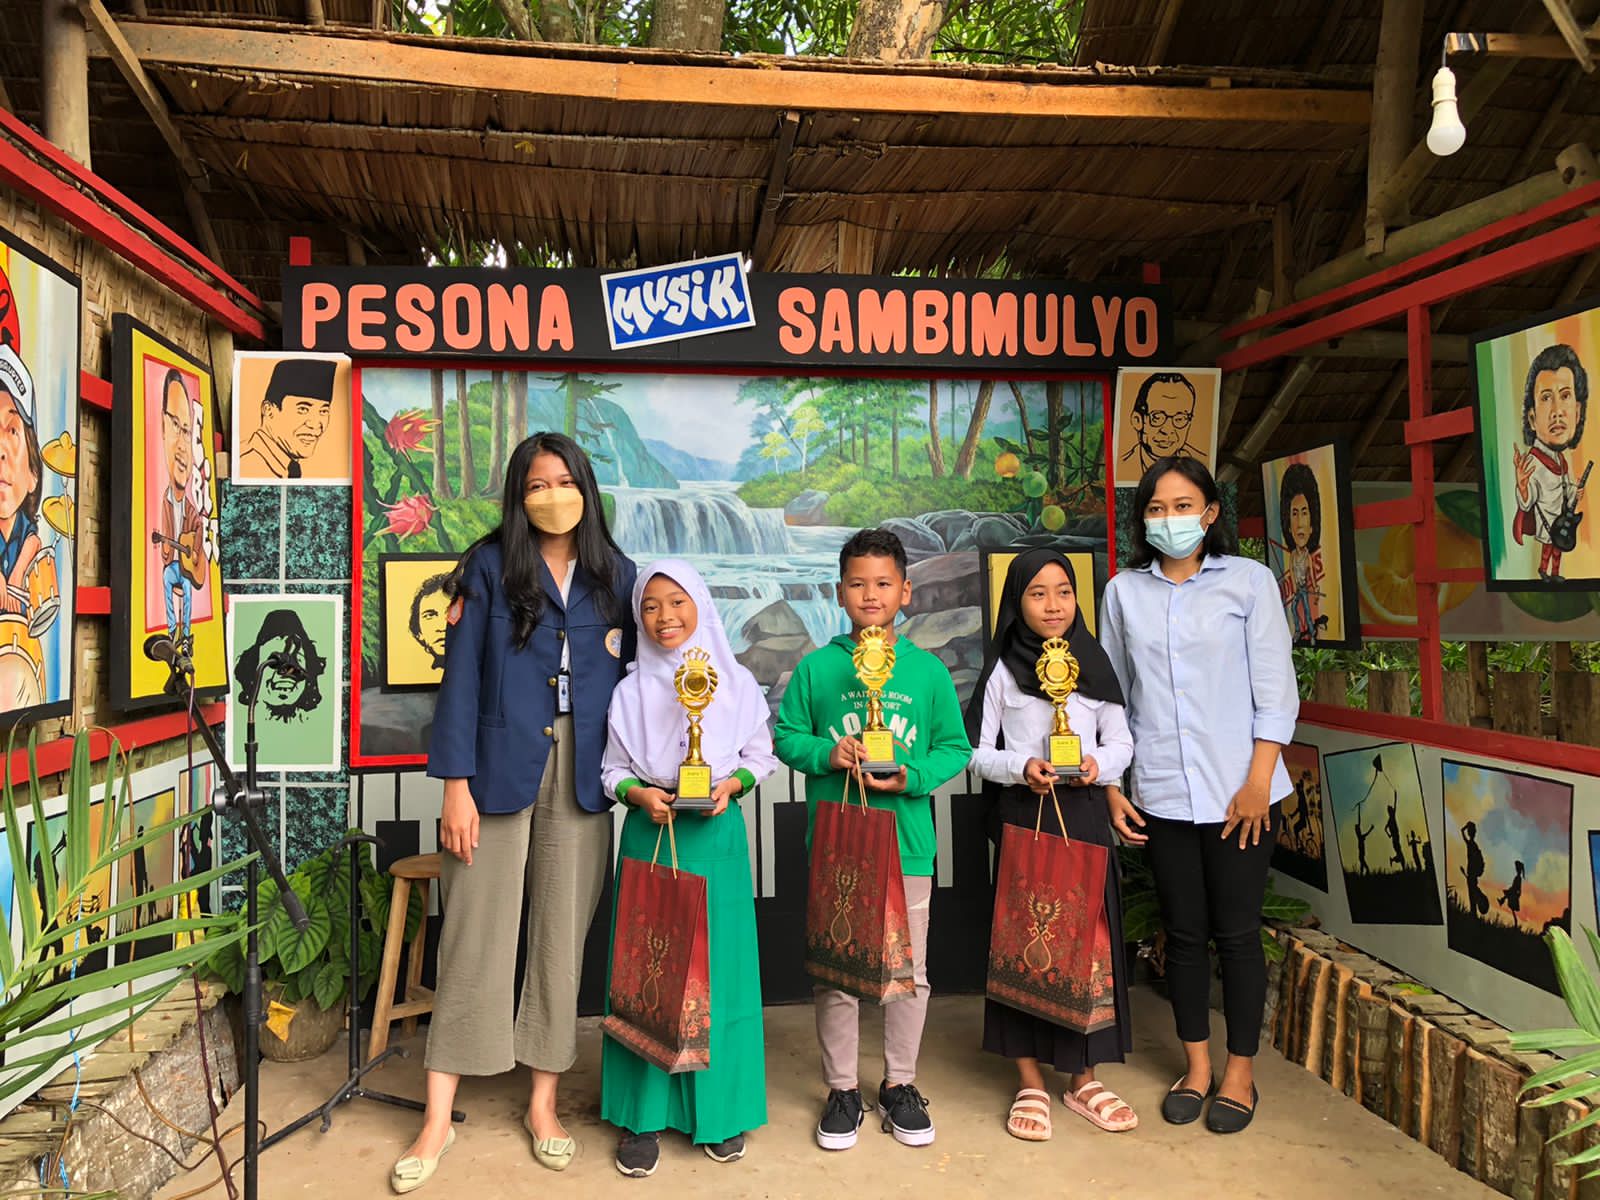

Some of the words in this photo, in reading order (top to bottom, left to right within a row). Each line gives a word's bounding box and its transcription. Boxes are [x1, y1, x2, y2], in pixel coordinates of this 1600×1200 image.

[301, 282, 575, 351] PESONA
[778, 286, 1159, 358] SAMBIMULYO
[847, 689, 887, 699] WAIG
